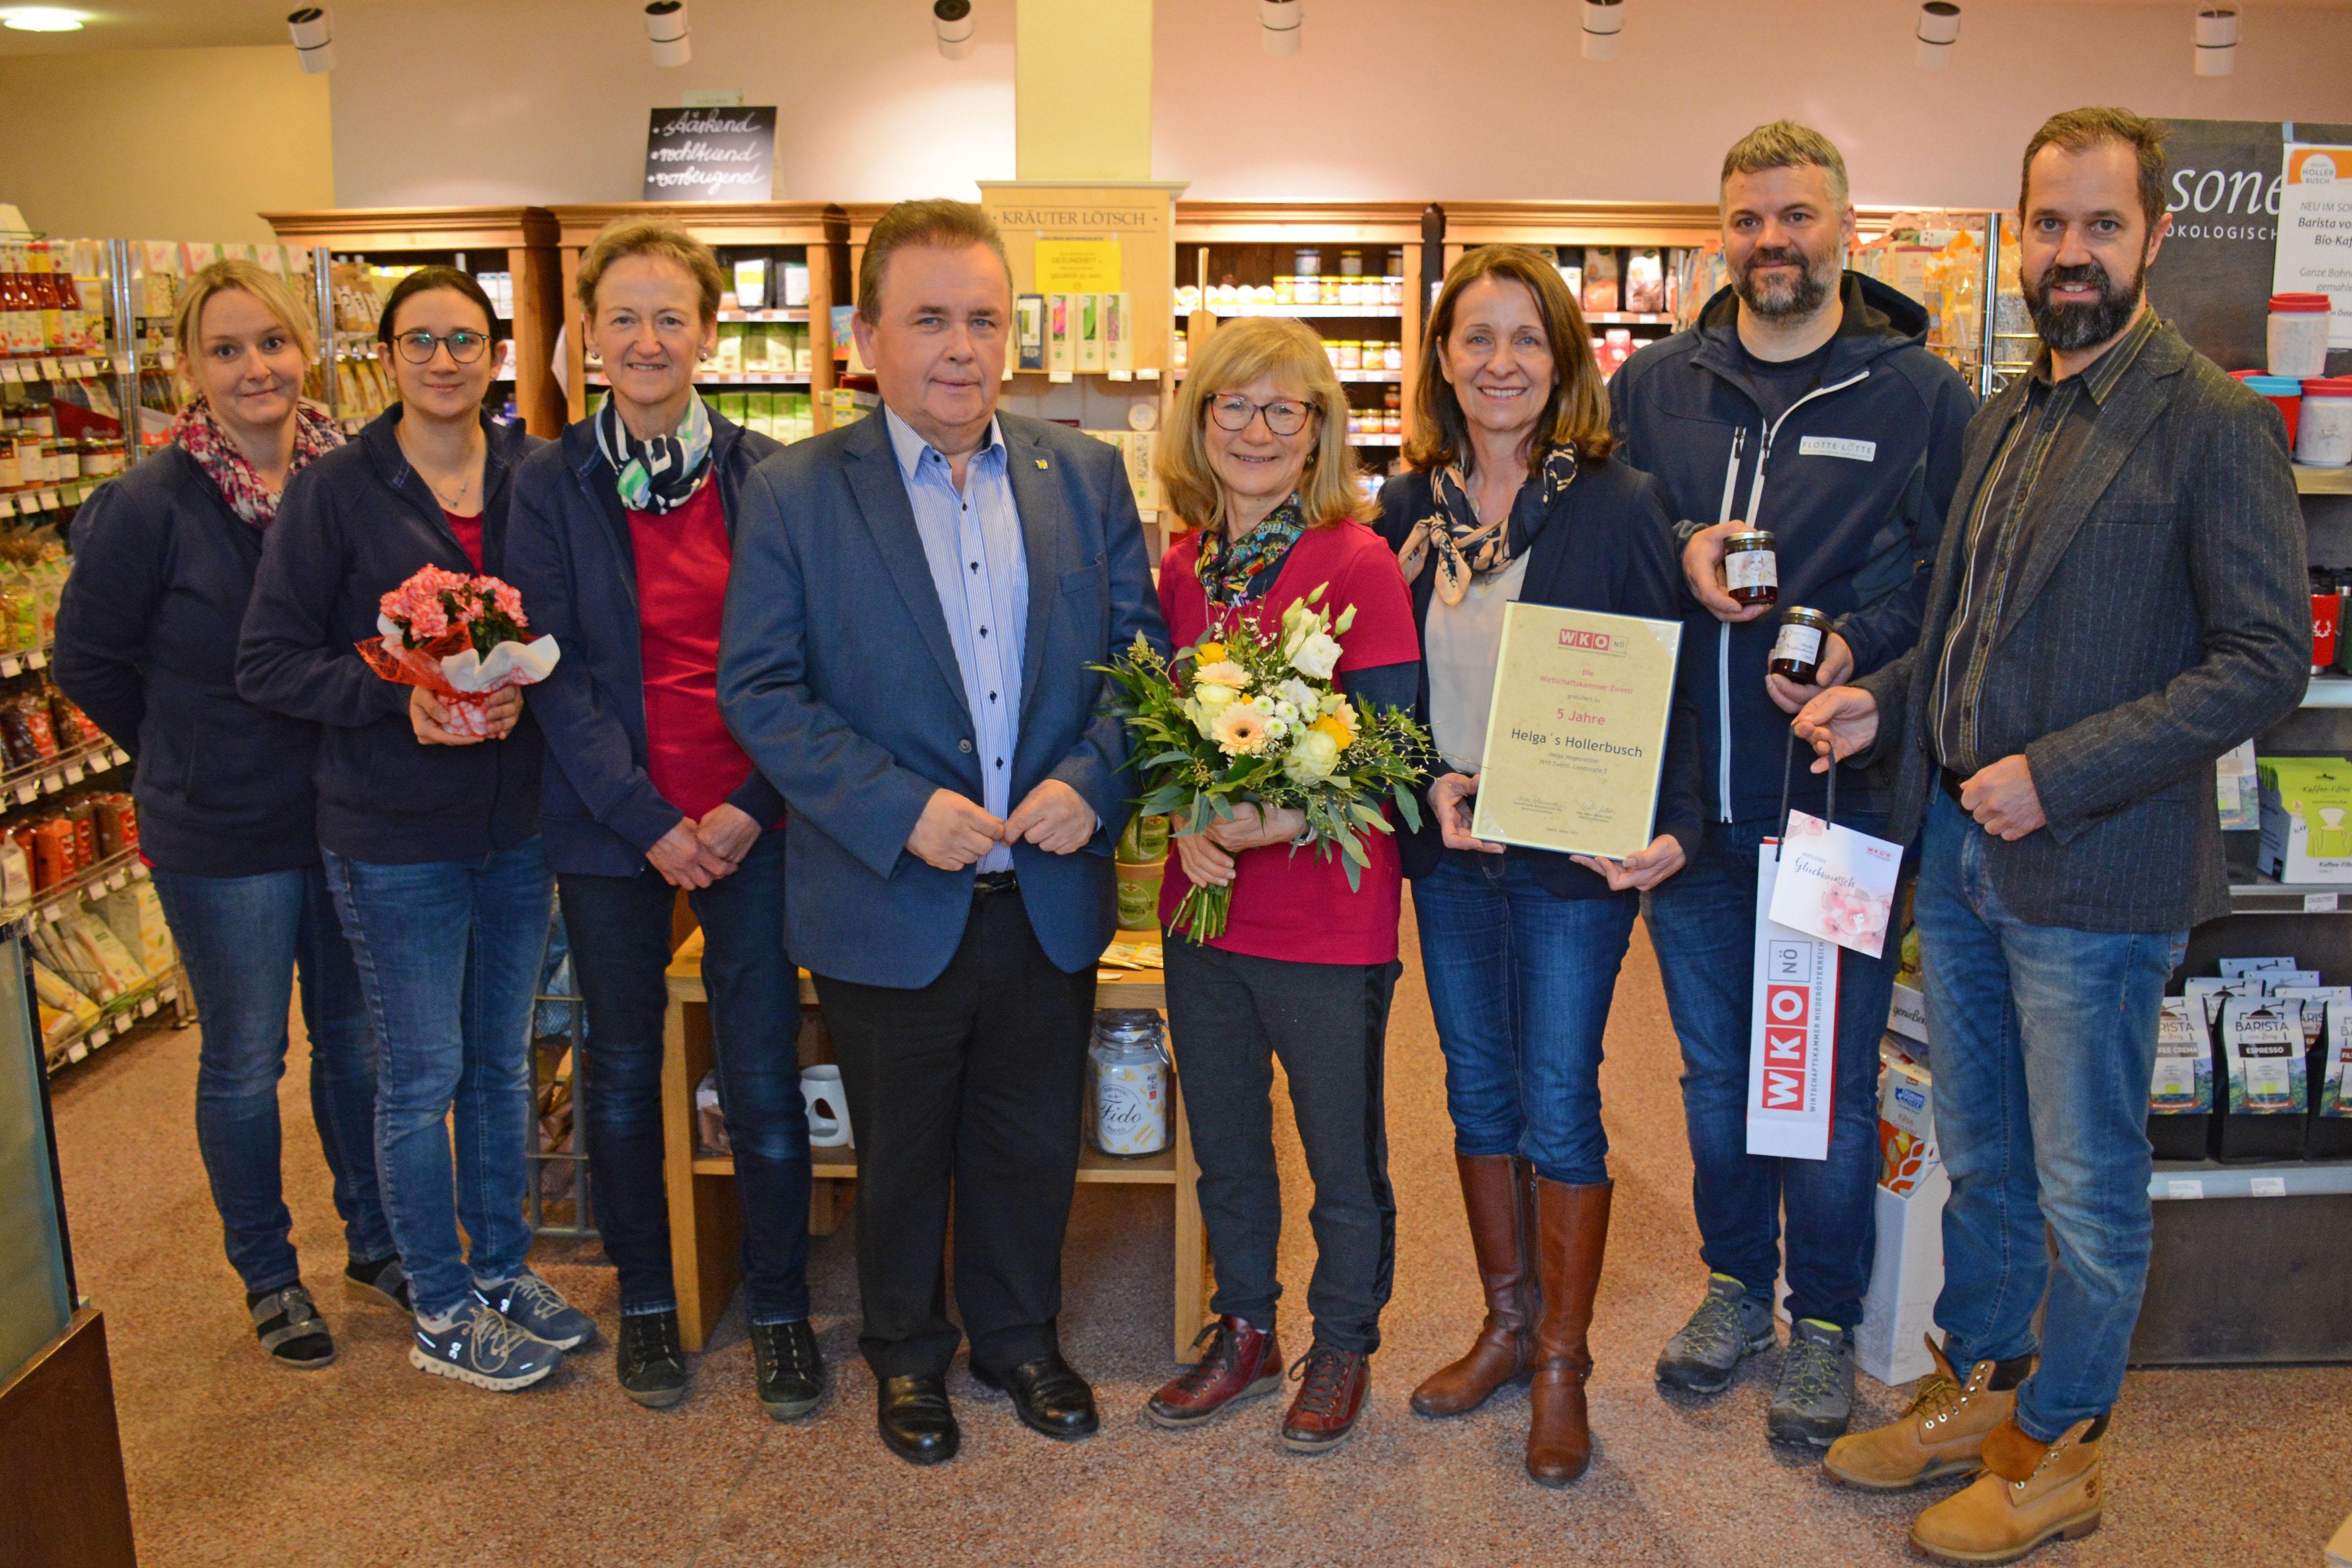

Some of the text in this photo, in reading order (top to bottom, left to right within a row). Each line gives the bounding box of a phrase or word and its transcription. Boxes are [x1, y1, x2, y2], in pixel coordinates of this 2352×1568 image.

[2301, 202, 2320, 211] NEU
[2323, 202, 2334, 212] IM
[1002, 209, 1145, 225] KRÄUTER LÖTSCH
[2298, 217, 2336, 229] Barista
[2300, 268, 2327, 277] Ganze
[1561, 630, 1608, 649] WKO
[1582, 669, 1594, 678] Die
[1540, 675, 1634, 695] Wirtschaftskammer Zwettl
[1567, 693, 1593, 703] gratuliert
[1556, 709, 1606, 726] 5 Jahre
[1565, 736, 1643, 758] Hollerbusch
[1779, 949, 1798, 974] NÖ
[1809, 941, 1825, 1113] WIRTSCHAFTSKAMMER NIEDERÖSTERREICH
[2235, 1021, 2290, 1032] BARISTA
[1767, 990, 1804, 1107] WKO
[2246, 1046, 2285, 1054] ESPRESSO
[1100, 1099, 1144, 1124] Fido
